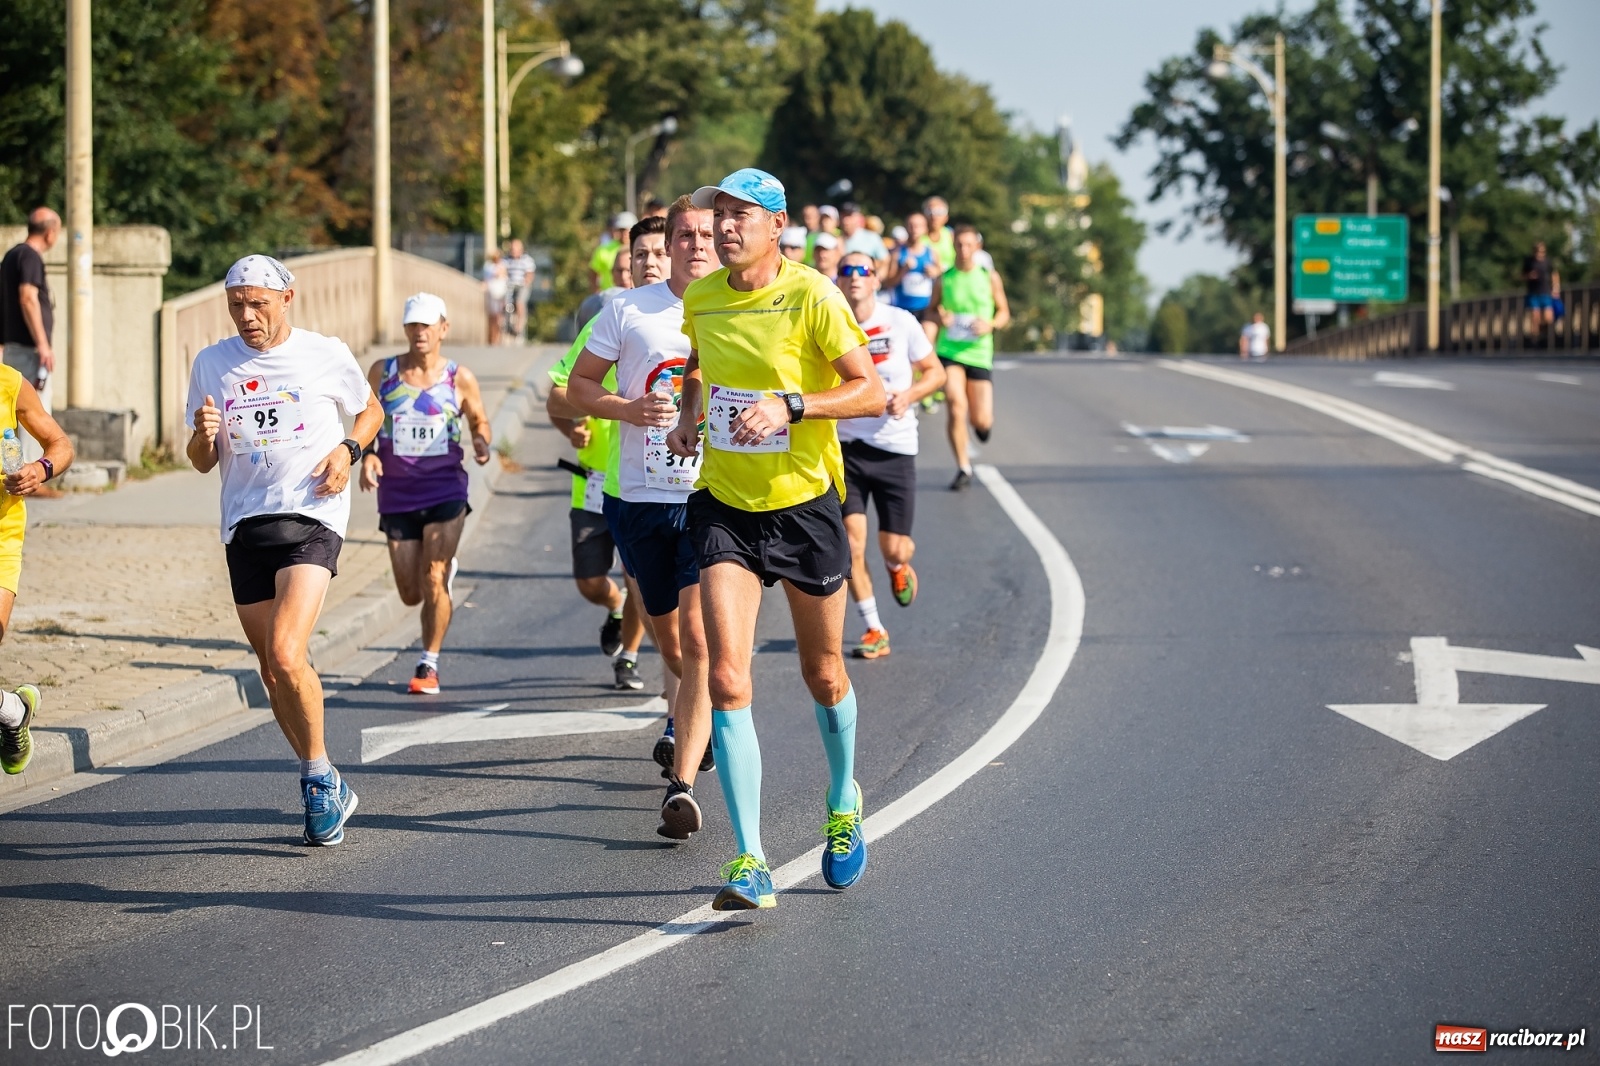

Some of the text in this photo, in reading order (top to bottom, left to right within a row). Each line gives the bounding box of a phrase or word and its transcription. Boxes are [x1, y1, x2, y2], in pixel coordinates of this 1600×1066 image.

[240, 384, 247, 396] I
[254, 408, 279, 429] 95
[412, 427, 434, 439] 181
